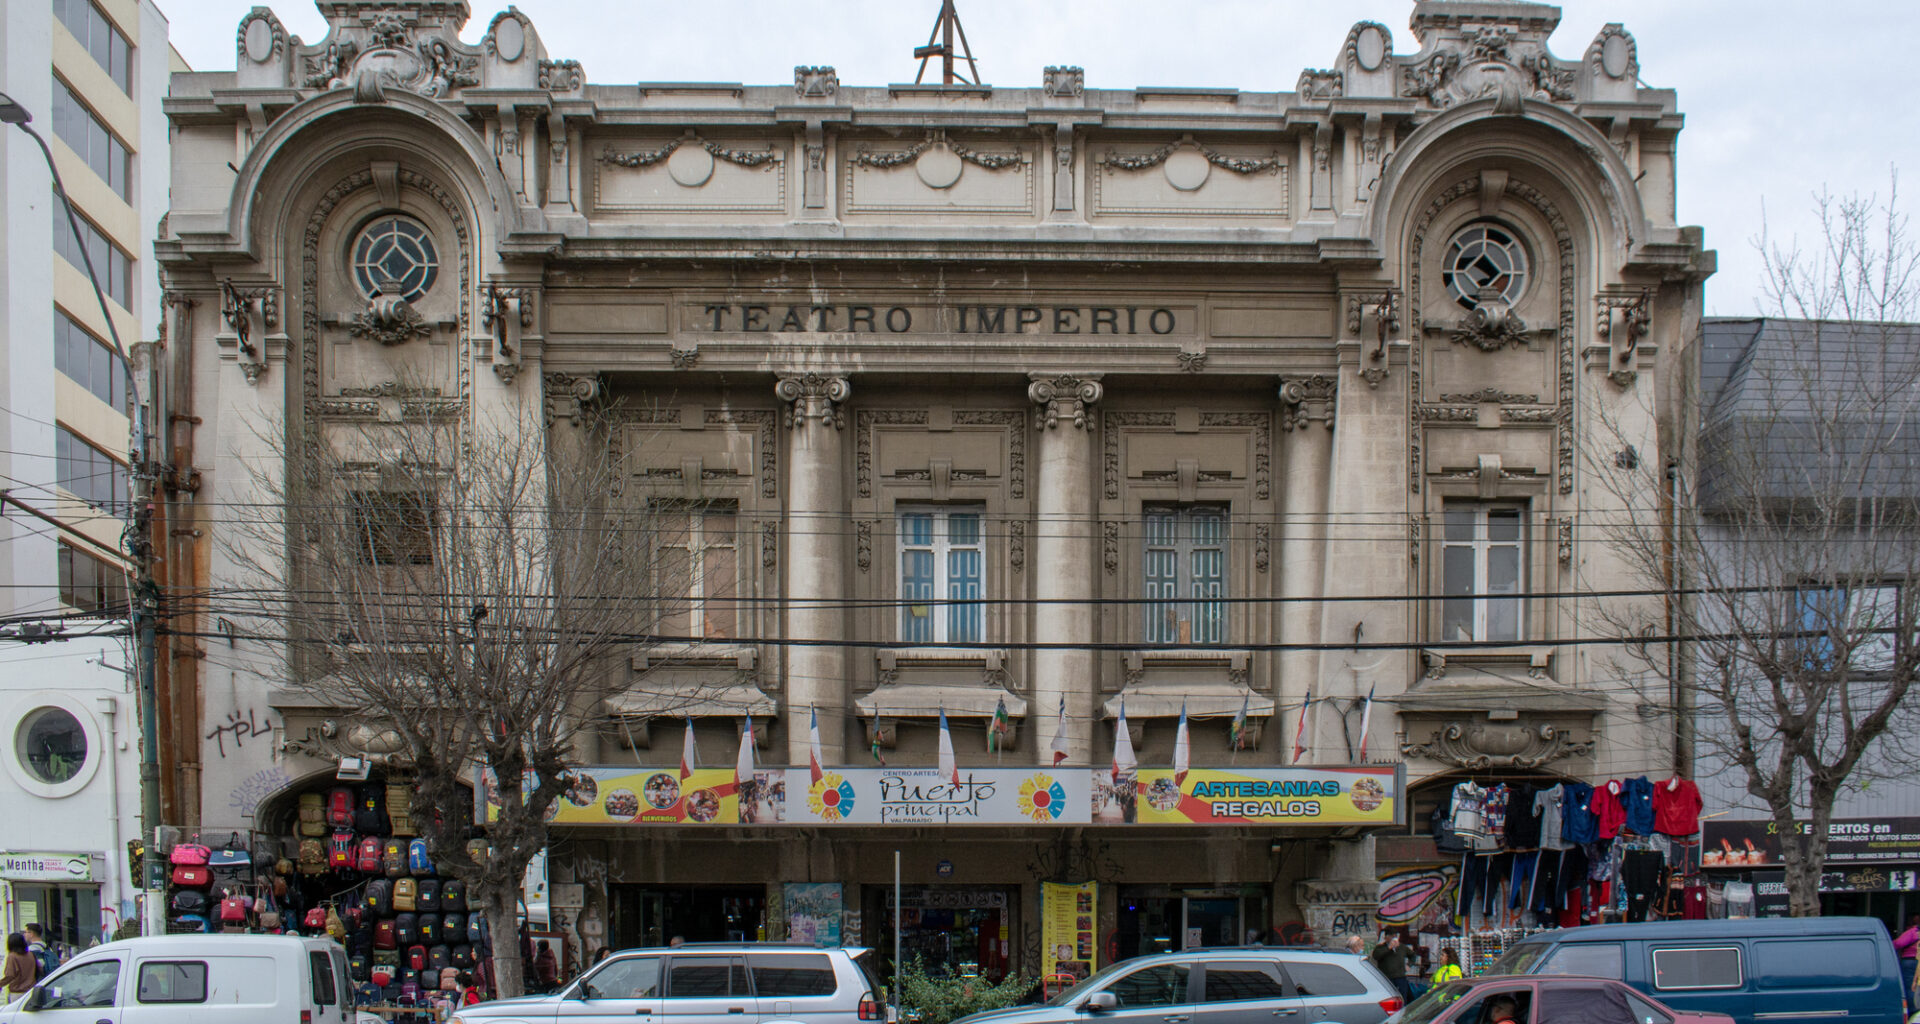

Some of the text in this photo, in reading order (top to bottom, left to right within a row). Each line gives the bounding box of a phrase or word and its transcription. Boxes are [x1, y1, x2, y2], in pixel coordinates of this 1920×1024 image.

[704, 304, 1176, 335] TEATRO IMPERIO
[879, 773, 996, 801] Puerto
[1192, 781, 1340, 797] ARTESANIAS
[880, 800, 979, 824] principal
[1212, 801, 1321, 817] REGALOS
[1803, 823, 1870, 834] EERTOS
[1872, 824, 1890, 834] en
[7, 859, 44, 871] Mentha
